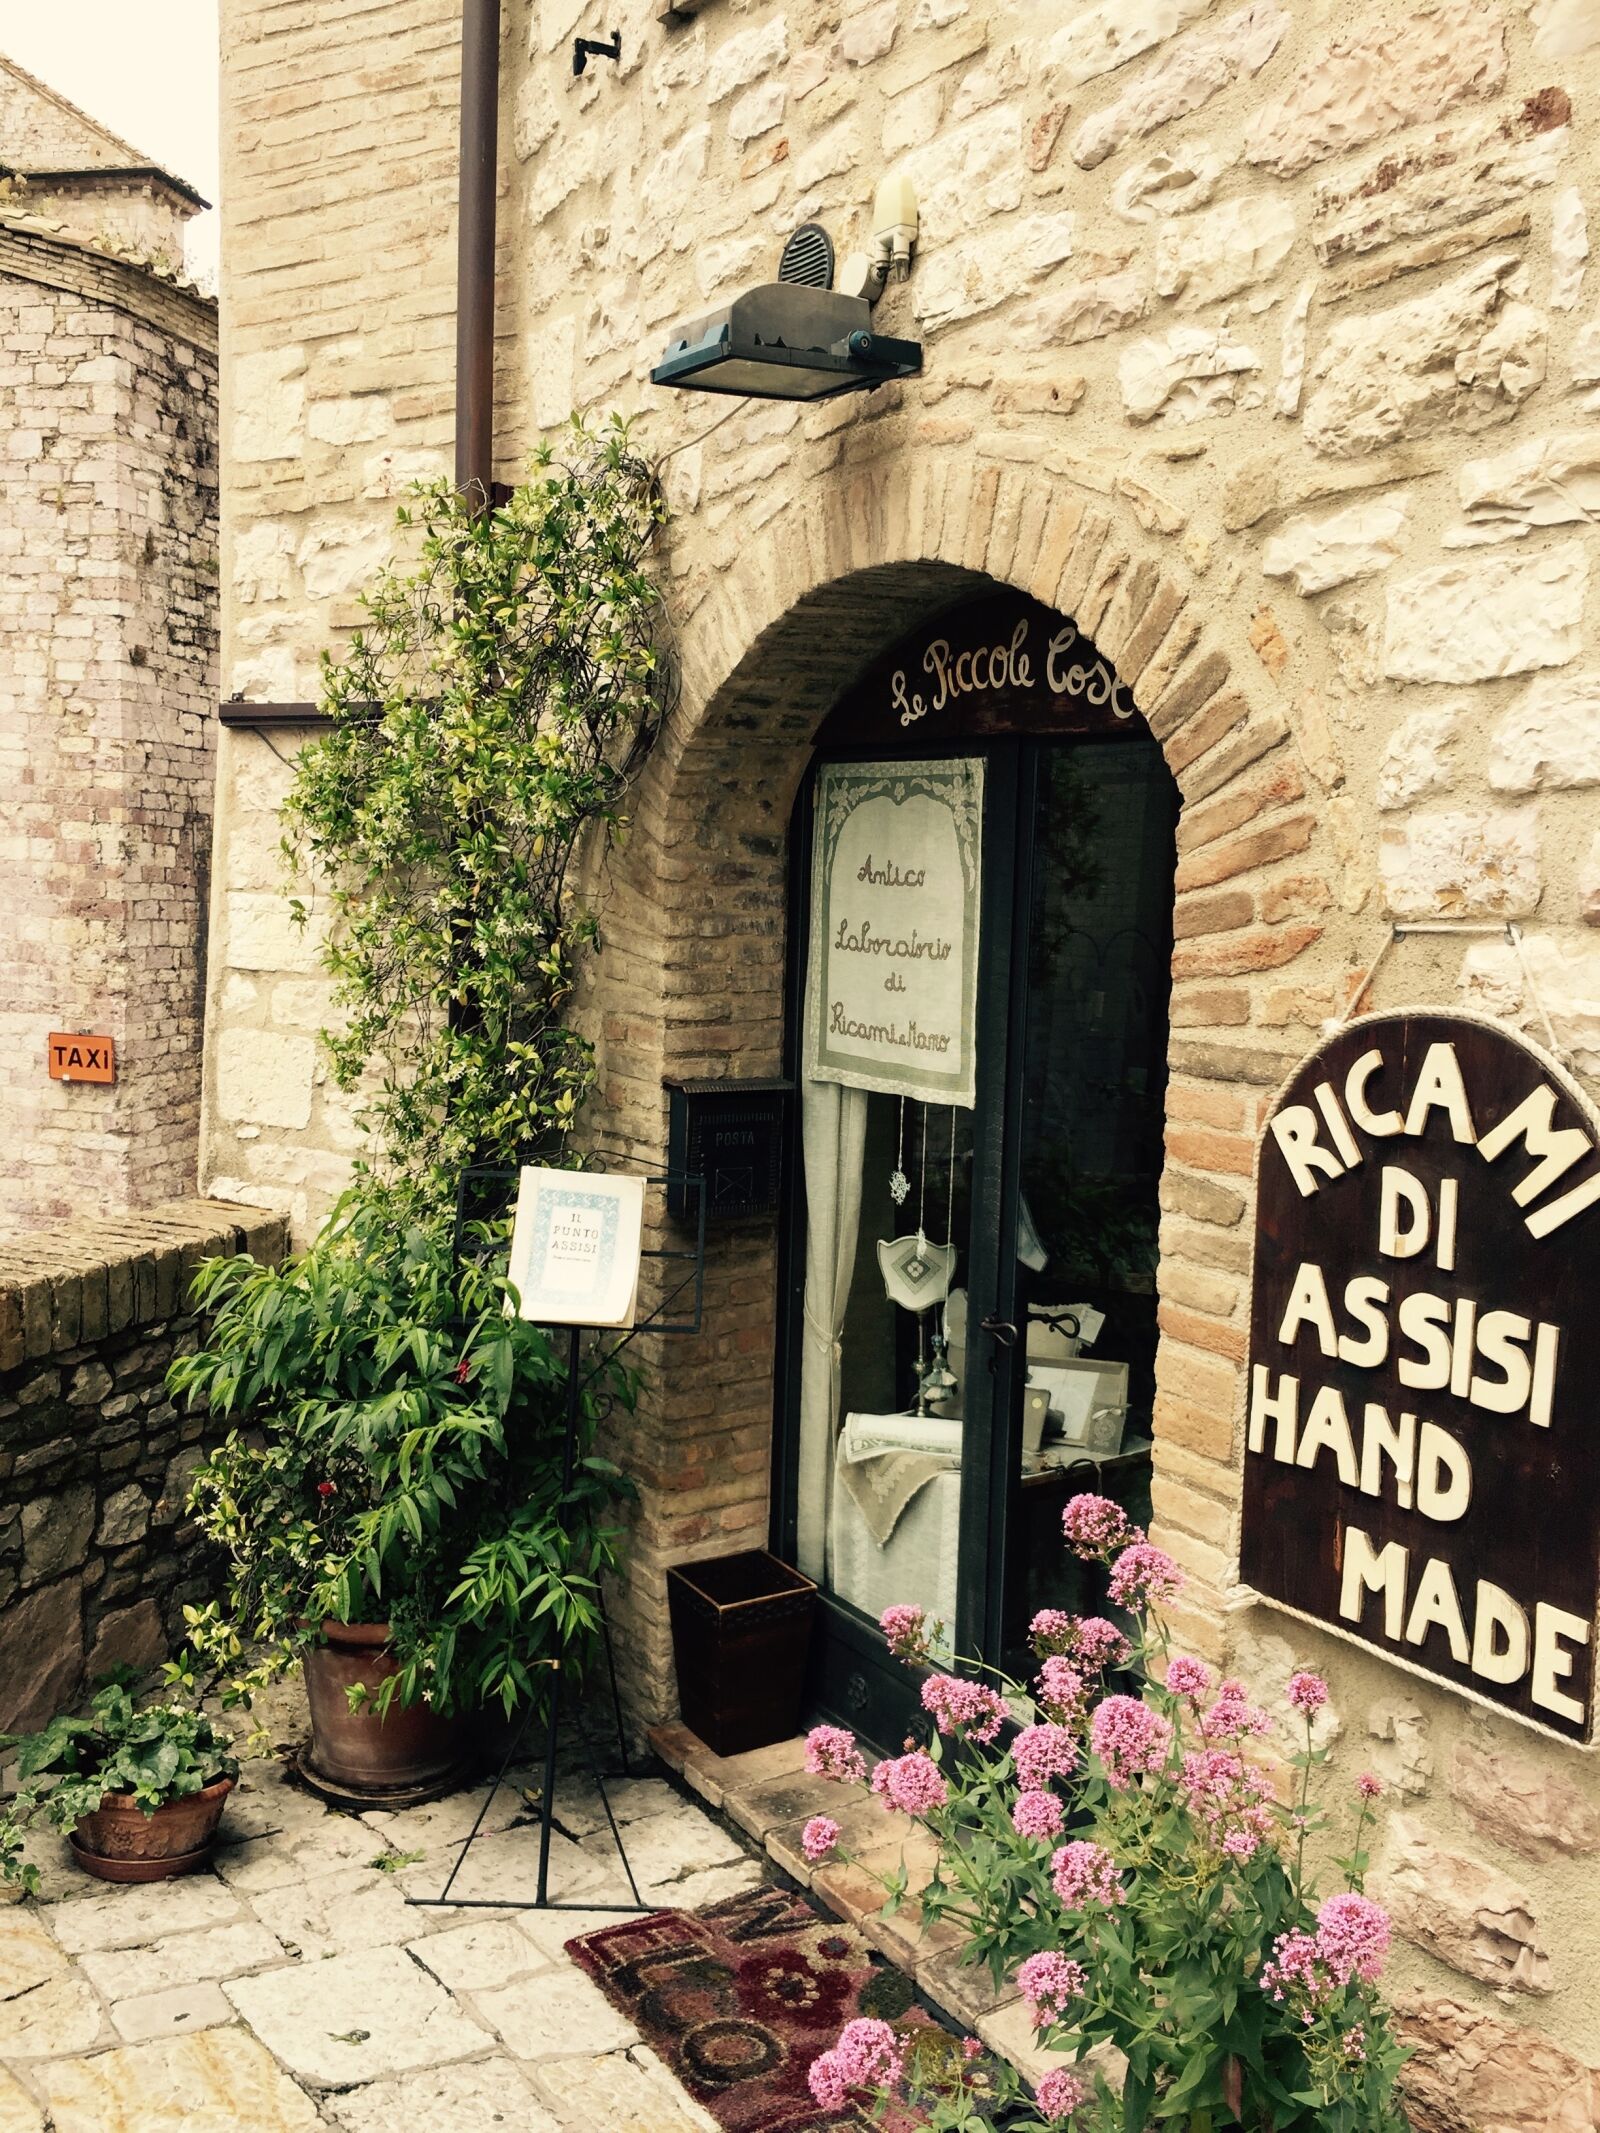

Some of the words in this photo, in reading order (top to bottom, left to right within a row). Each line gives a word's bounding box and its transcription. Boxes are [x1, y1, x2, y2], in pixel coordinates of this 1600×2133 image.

[892, 670, 928, 727] Le
[923, 618, 1036, 711] Piccole
[857, 854, 926, 887] Antico
[834, 918, 952, 961] Laboratorio
[884, 972, 906, 992] di
[830, 1001, 898, 1045] Ricami
[53, 1046, 109, 1070] TAXI
[715, 1131, 754, 1147] POSTA
[1270, 1042, 1600, 1240] RICAMI
[553, 1225, 599, 1240] PUNTO
[571, 1213, 582, 1224] IL
[1378, 1165, 1459, 1272] DI
[551, 1240, 597, 1254] ASSISI
[1278, 1263, 1560, 1429] ASSISI
[1248, 1363, 1473, 1523] HAND
[1339, 1525, 1591, 1726] MADE
